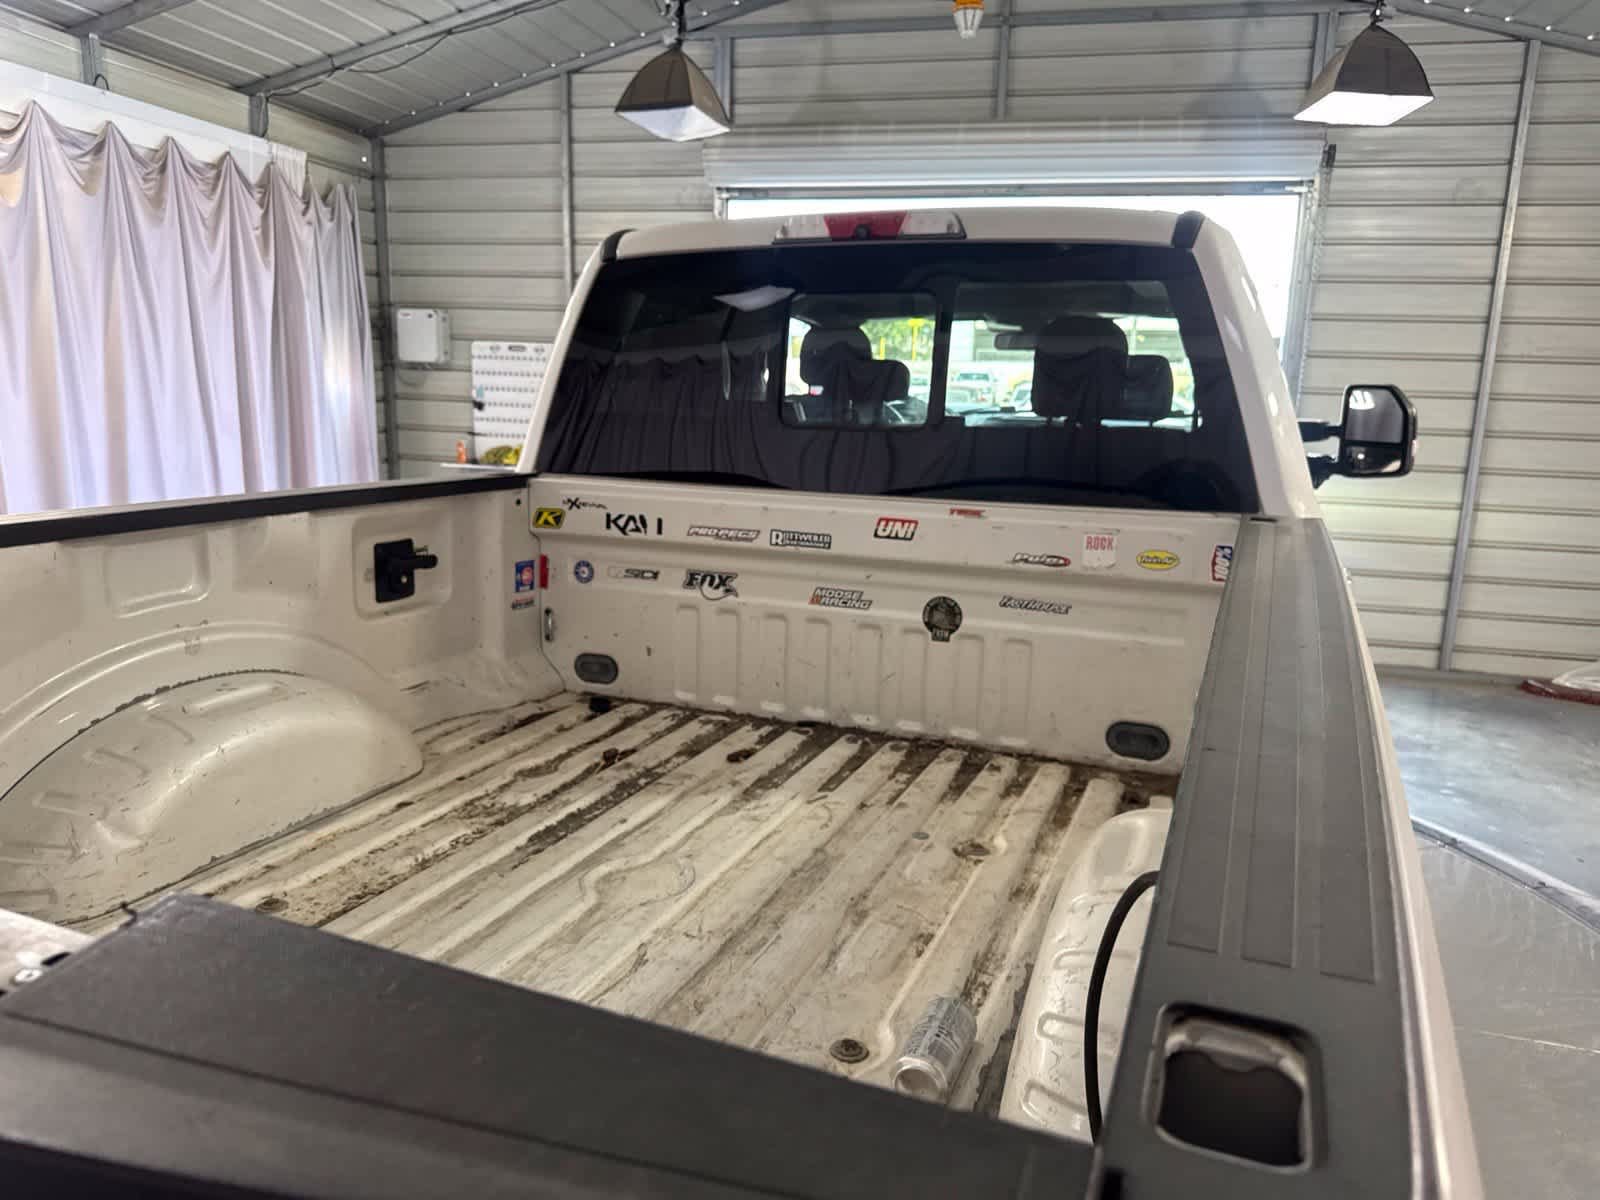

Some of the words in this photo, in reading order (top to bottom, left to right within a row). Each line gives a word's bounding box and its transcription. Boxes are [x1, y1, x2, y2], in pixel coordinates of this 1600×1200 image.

[876, 520, 916, 539] UNI
[1086, 535, 1114, 551] ROCK
[685, 571, 738, 598] FOX
[814, 587, 863, 600] MOOSE
[819, 598, 871, 609] RACING
